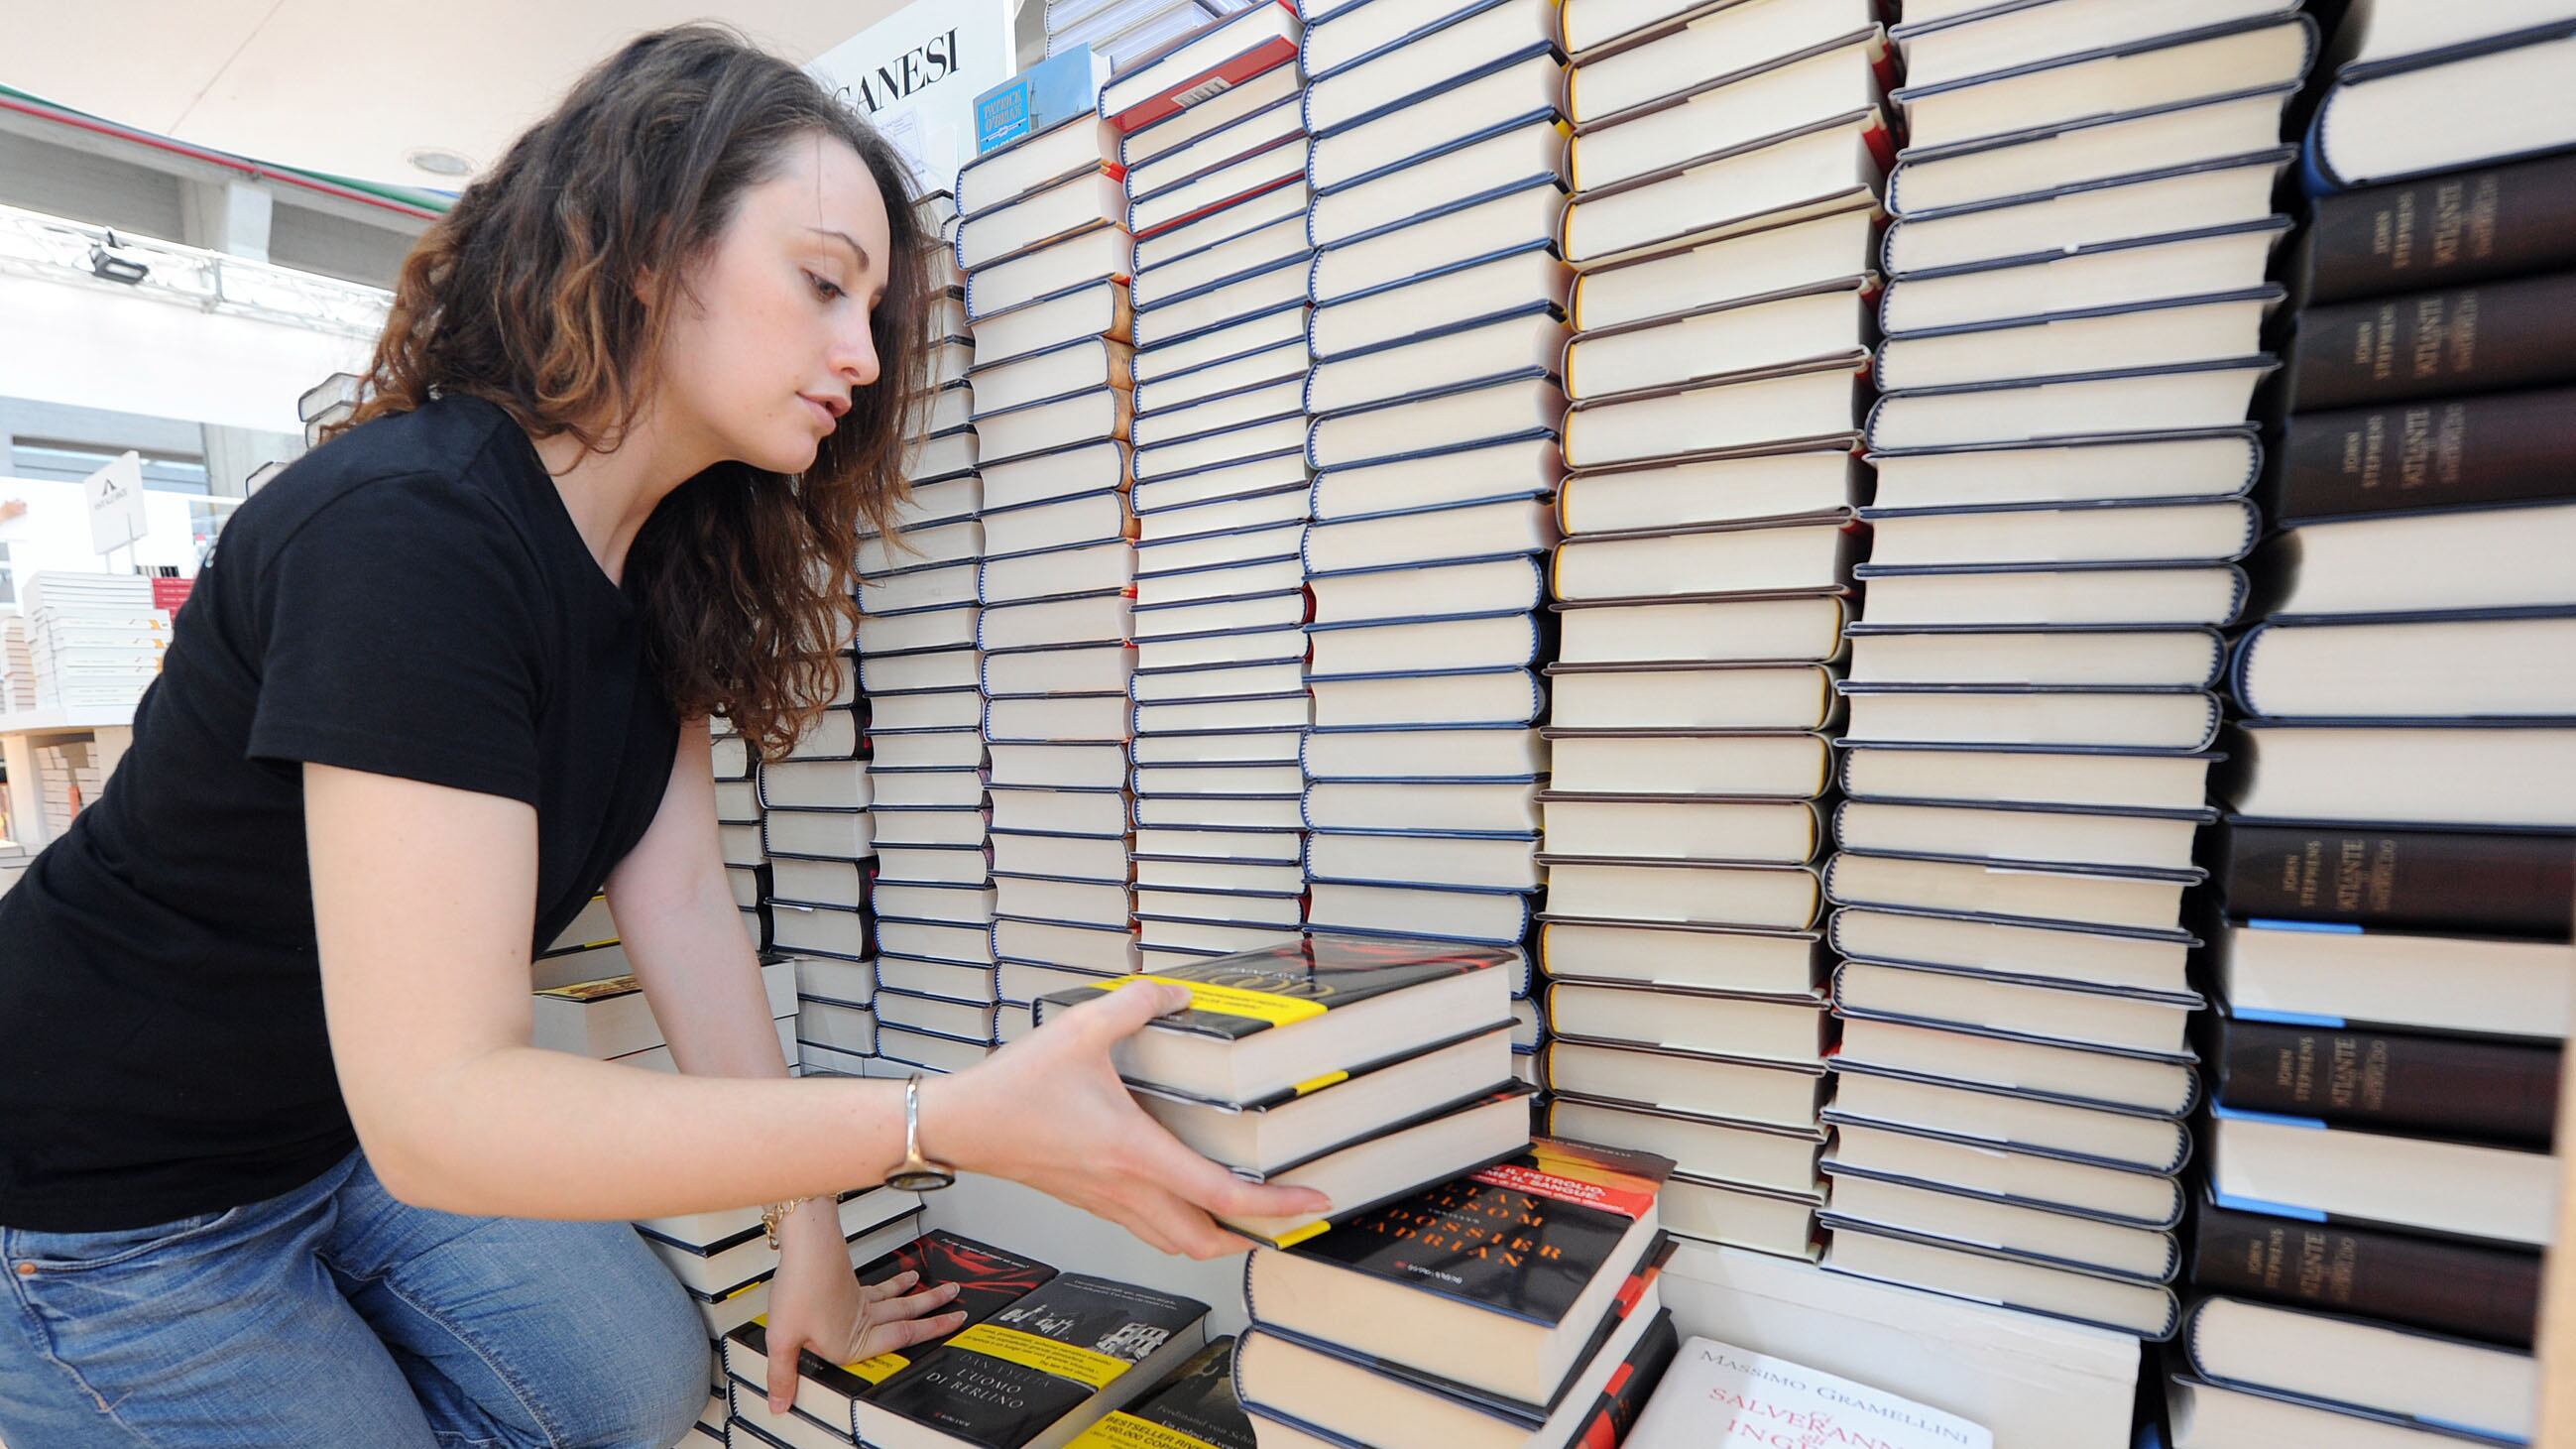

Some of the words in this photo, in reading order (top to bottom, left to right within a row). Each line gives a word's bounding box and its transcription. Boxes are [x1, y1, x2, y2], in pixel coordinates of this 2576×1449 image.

[1388, 1207, 1563, 1262] DOSSIER
[926, 1372, 949, 1386] DI
[951, 1381, 1023, 1408] BERLINO
[956, 1368, 1022, 1394] L'UOMO
[1699, 1350, 1808, 1391] MASSIMO
[1816, 1387, 1970, 1446] GRAMELLINI
[1105, 1415, 1174, 1443] BESTSELLER
